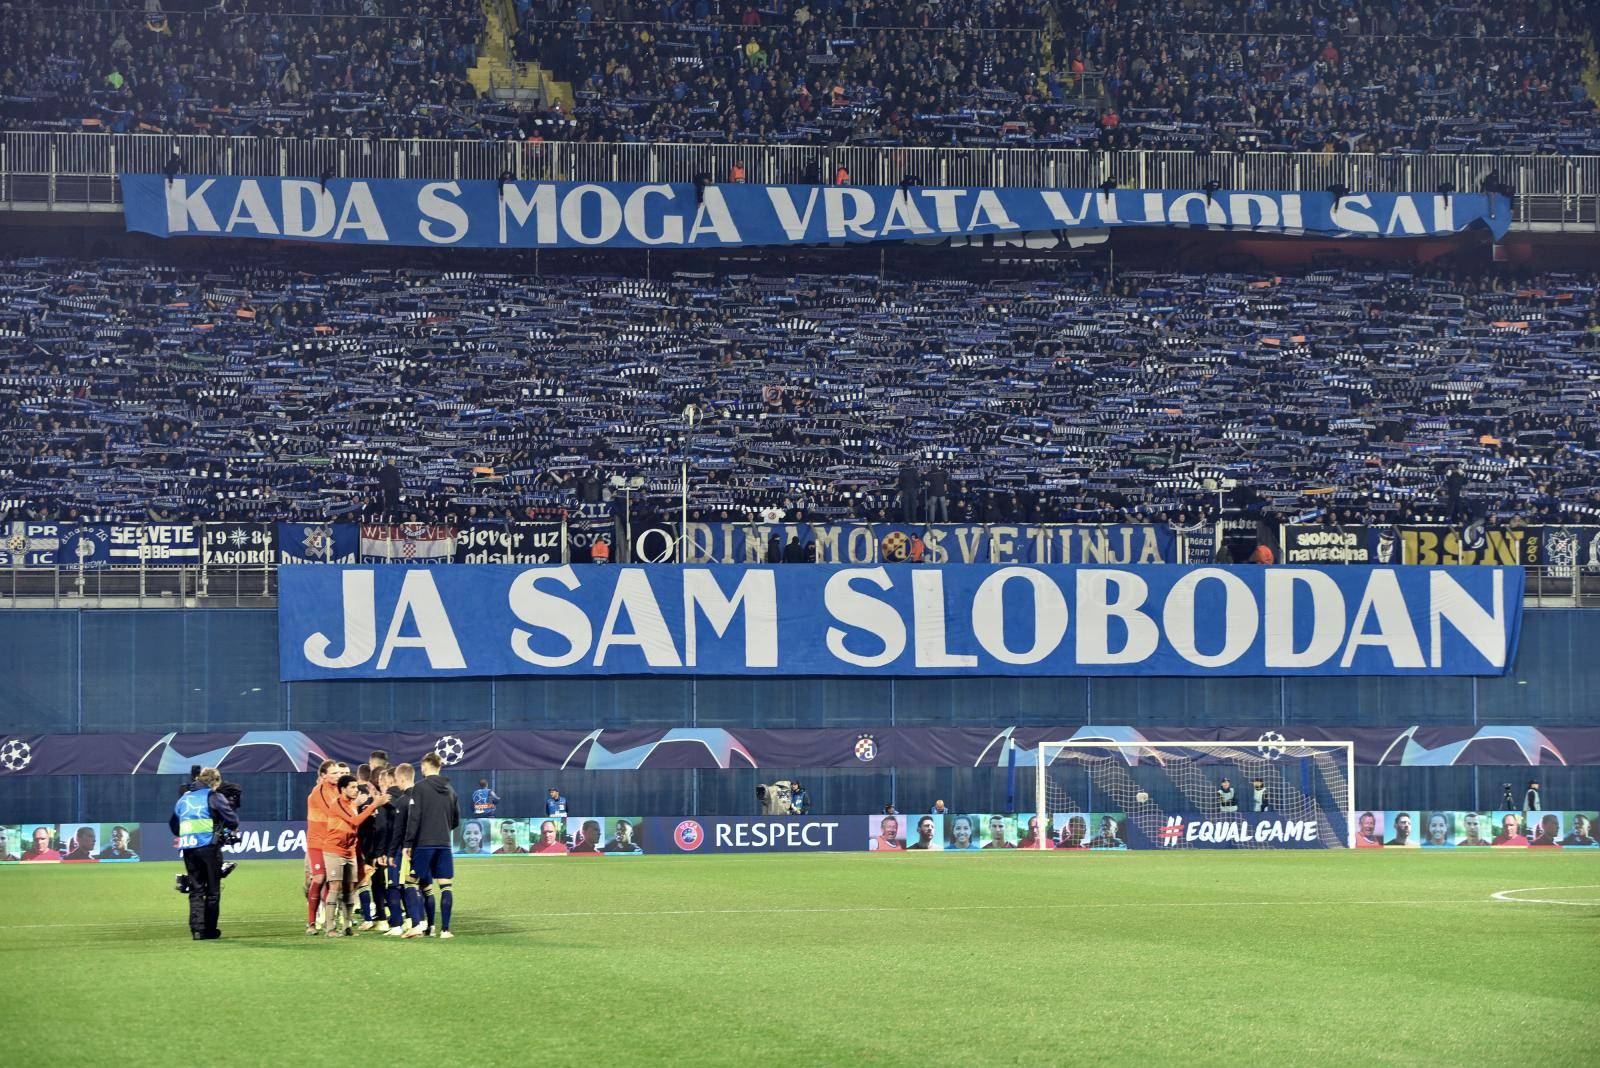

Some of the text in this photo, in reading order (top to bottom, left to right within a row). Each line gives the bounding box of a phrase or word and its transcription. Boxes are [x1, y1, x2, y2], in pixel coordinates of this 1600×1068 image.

[166, 178, 389, 240] KADA
[417, 181, 469, 243] S
[498, 184, 742, 244] MOGA
[766, 188, 1019, 242] VRATA
[111, 525, 195, 544] SESVETE
[533, 532, 559, 548] uz
[921, 526, 1166, 564] SVETINJA
[303, 564, 1503, 674] JA SAM SLOBODAN
[716, 823, 838, 846] RESPECT
[1253, 821, 1318, 843] GAME
